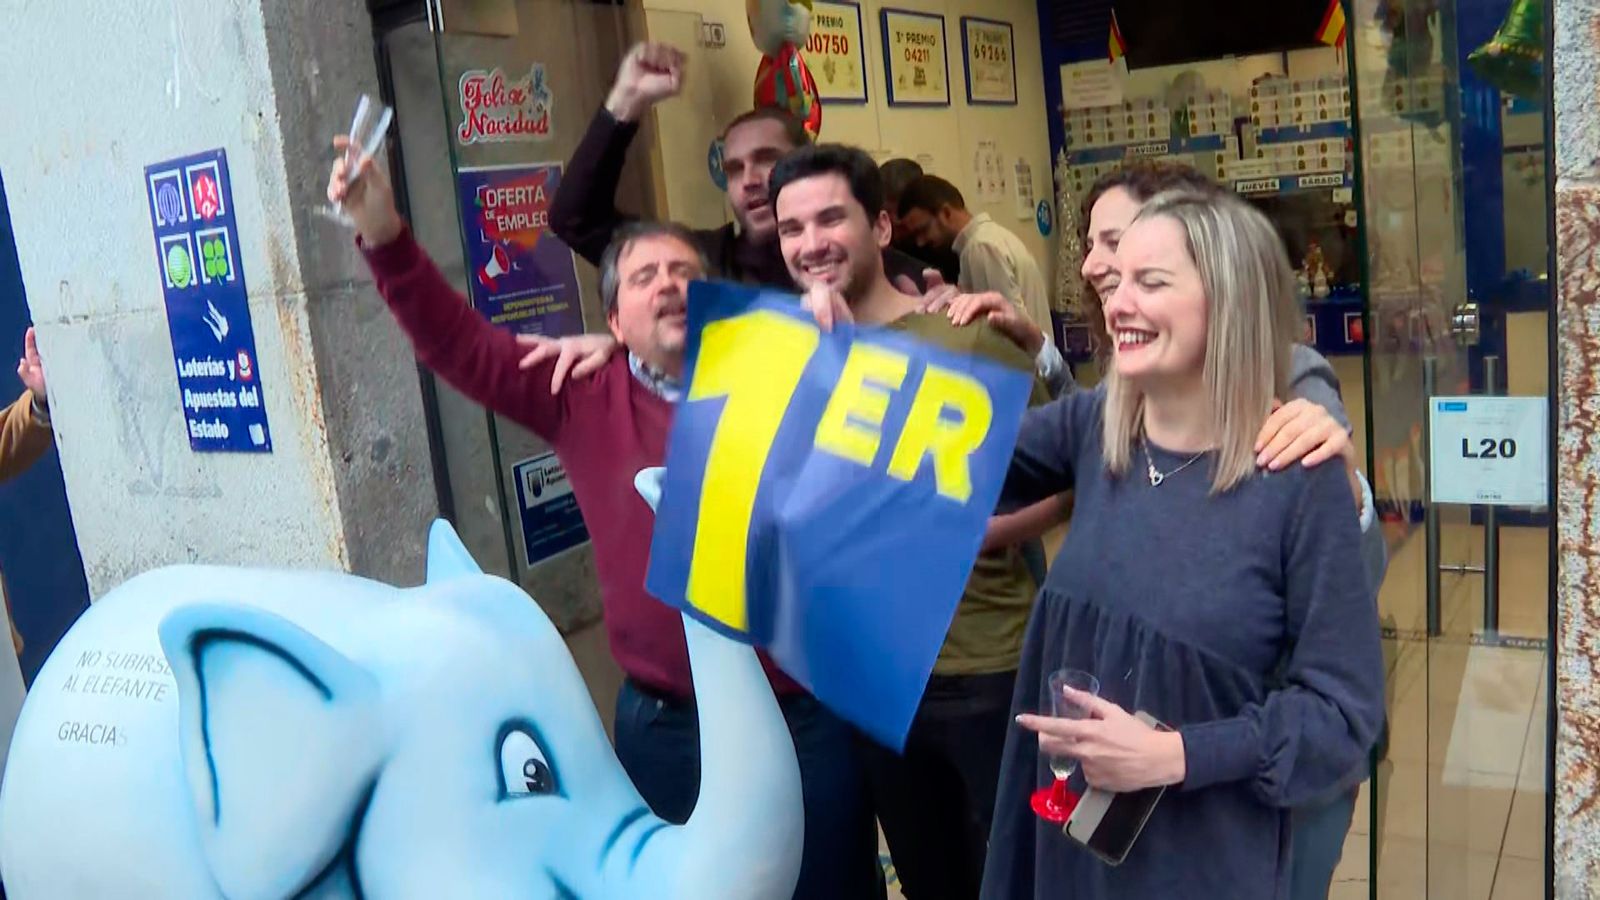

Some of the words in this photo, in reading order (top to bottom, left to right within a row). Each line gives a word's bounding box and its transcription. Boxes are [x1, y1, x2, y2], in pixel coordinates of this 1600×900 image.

[816, 14, 844, 28] PREMIO
[906, 32, 936, 47] PREMIO
[904, 48, 931, 63] 04211
[973, 44, 1007, 62] 69266
[461, 109, 549, 139] Navidad
[485, 185, 545, 208] OFERTA
[1240, 182, 1277, 192] JUEVES
[485, 209, 496, 220] DE
[178, 354, 226, 378] Loterías
[227, 359, 236, 381] y
[184, 387, 237, 413] Apuestas
[238, 384, 259, 408] del
[189, 417, 229, 439] Estado
[1462, 438, 1516, 458] L20
[76, 650, 102, 668] NO
[62, 674, 80, 693] AL
[82, 675, 169, 702] ELEFANTE
